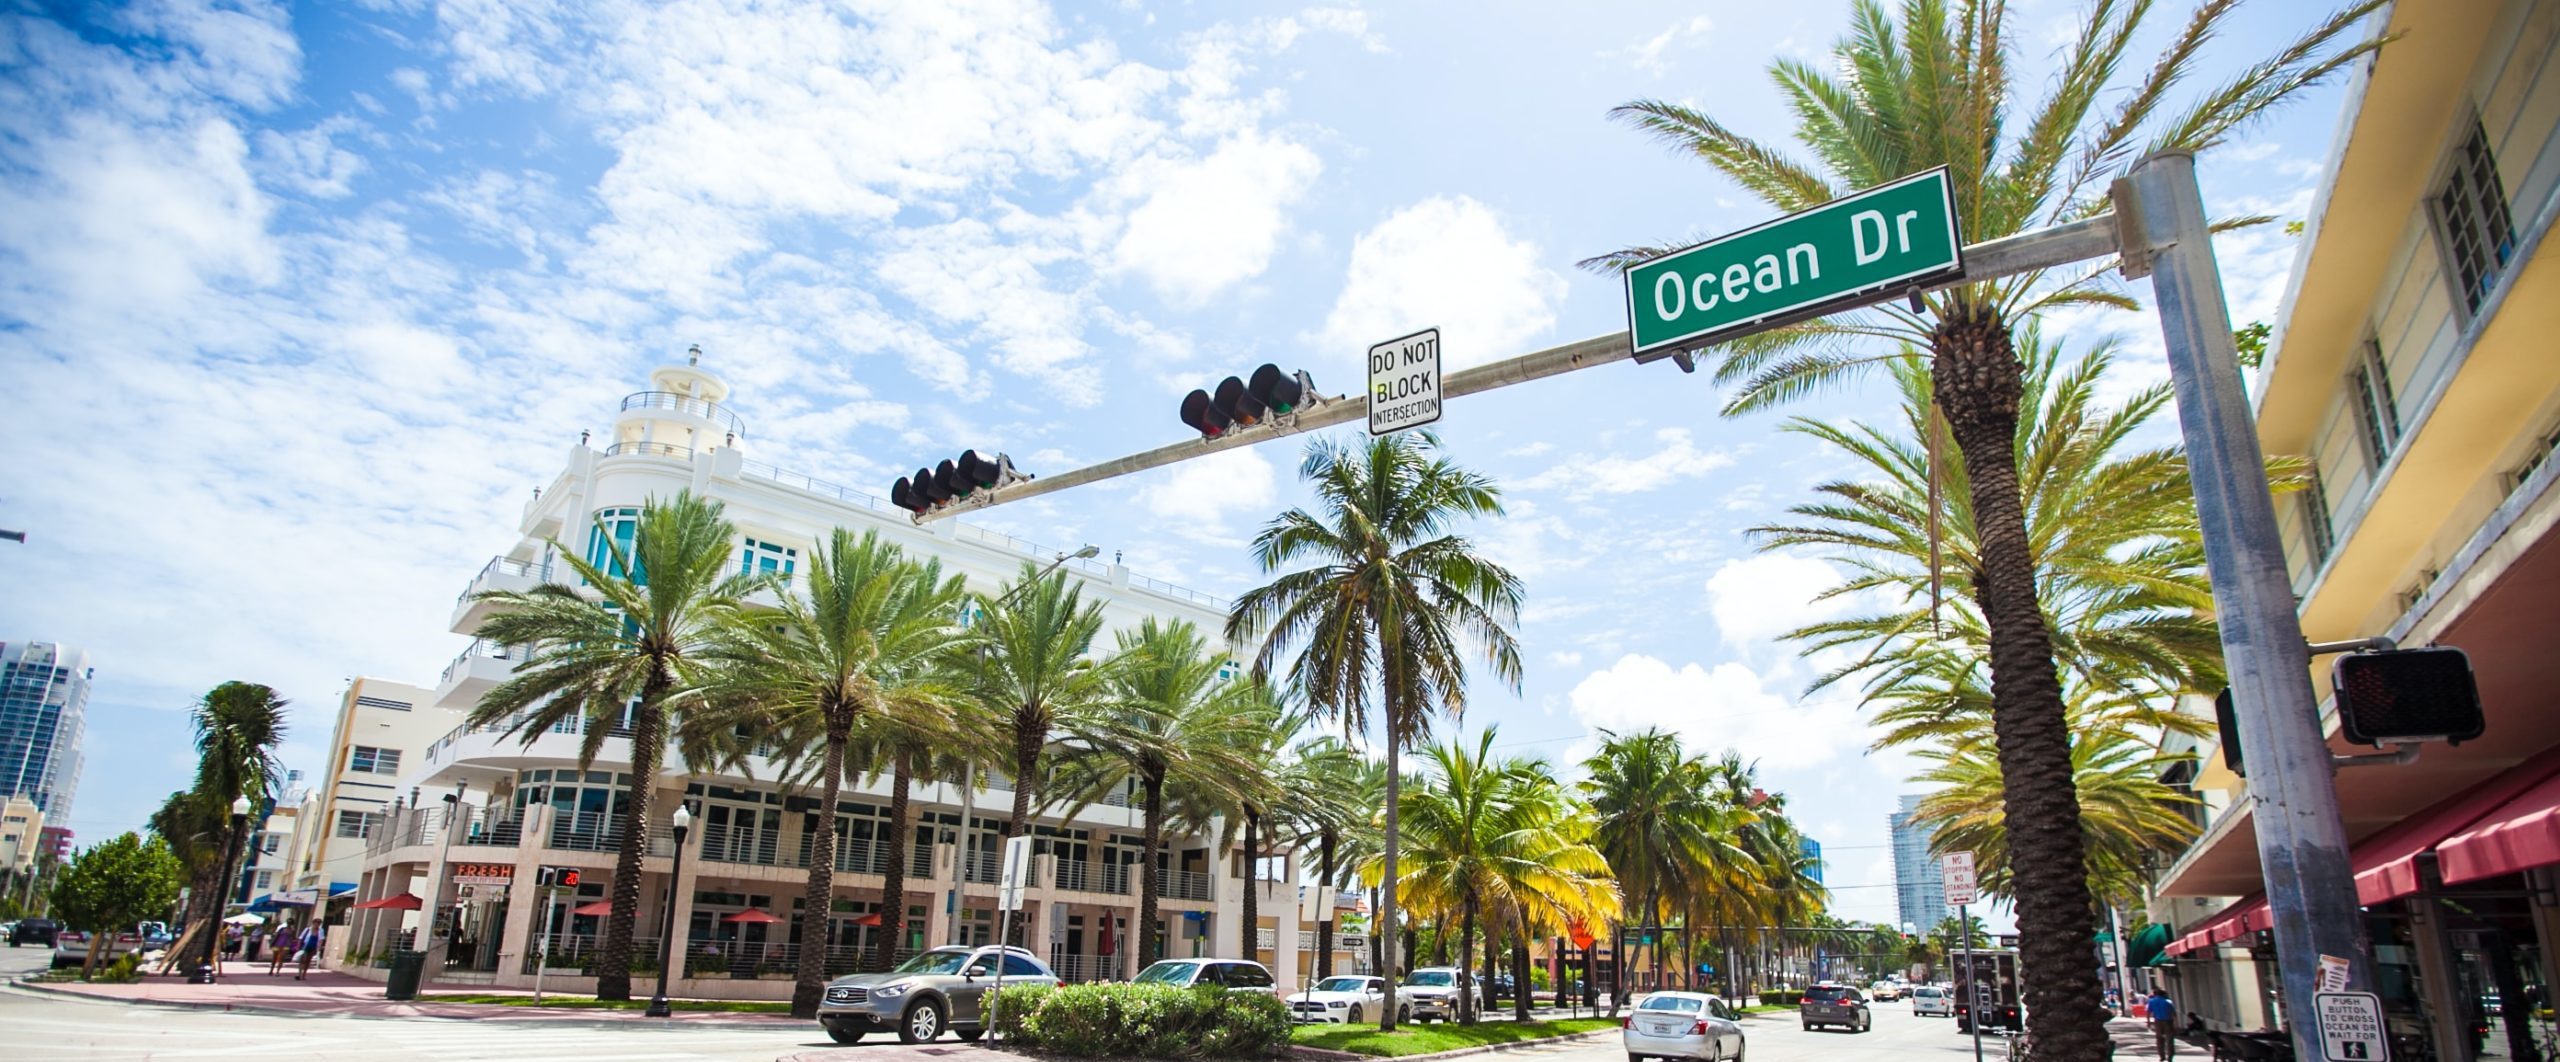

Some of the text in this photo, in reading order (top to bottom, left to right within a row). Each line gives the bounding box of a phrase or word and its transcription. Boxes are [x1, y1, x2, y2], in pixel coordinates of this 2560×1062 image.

[1655, 209, 1917, 321] Ocean Dr
[1373, 339, 1435, 374] DO NOT
[1377, 370, 1432, 403] BLOCK
[1373, 397, 1438, 426] INTERSECTION
[1952, 856, 1962, 864] NO
[458, 864, 511, 877] FRESH
[565, 872, 577, 885] 20
[2328, 1006, 2367, 1014] BUTTON
[2324, 1014, 2375, 1023] TO CROSS
[2325, 1023, 2359, 1031] OCEAN
[2356, 1032, 2377, 1040] FOR
